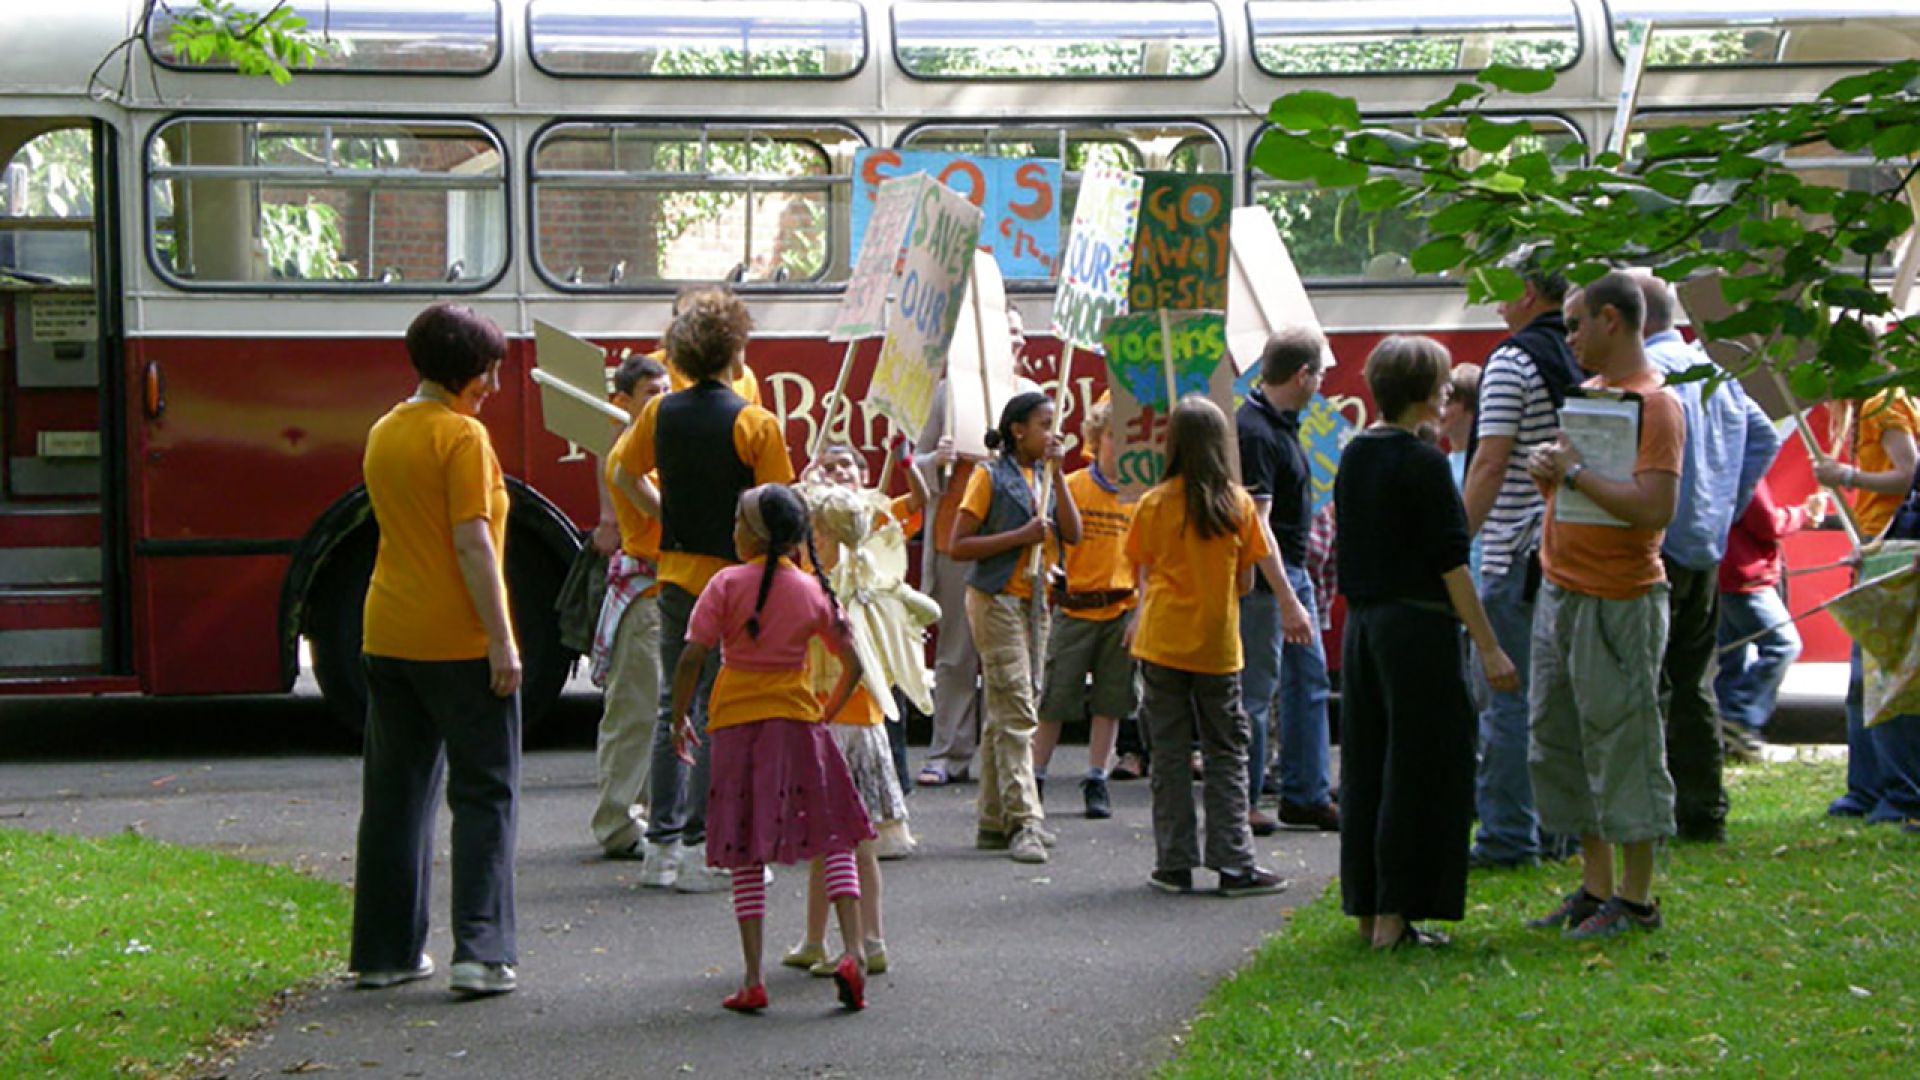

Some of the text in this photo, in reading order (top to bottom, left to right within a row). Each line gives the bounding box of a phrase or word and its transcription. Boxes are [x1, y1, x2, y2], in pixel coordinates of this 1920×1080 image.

[914, 185, 960, 274] SAVE
[1149, 185, 1222, 232] GO
[1070, 233, 1112, 292] OUR
[901, 269, 948, 336] OUR
[1054, 278, 1116, 343] SCHOO
